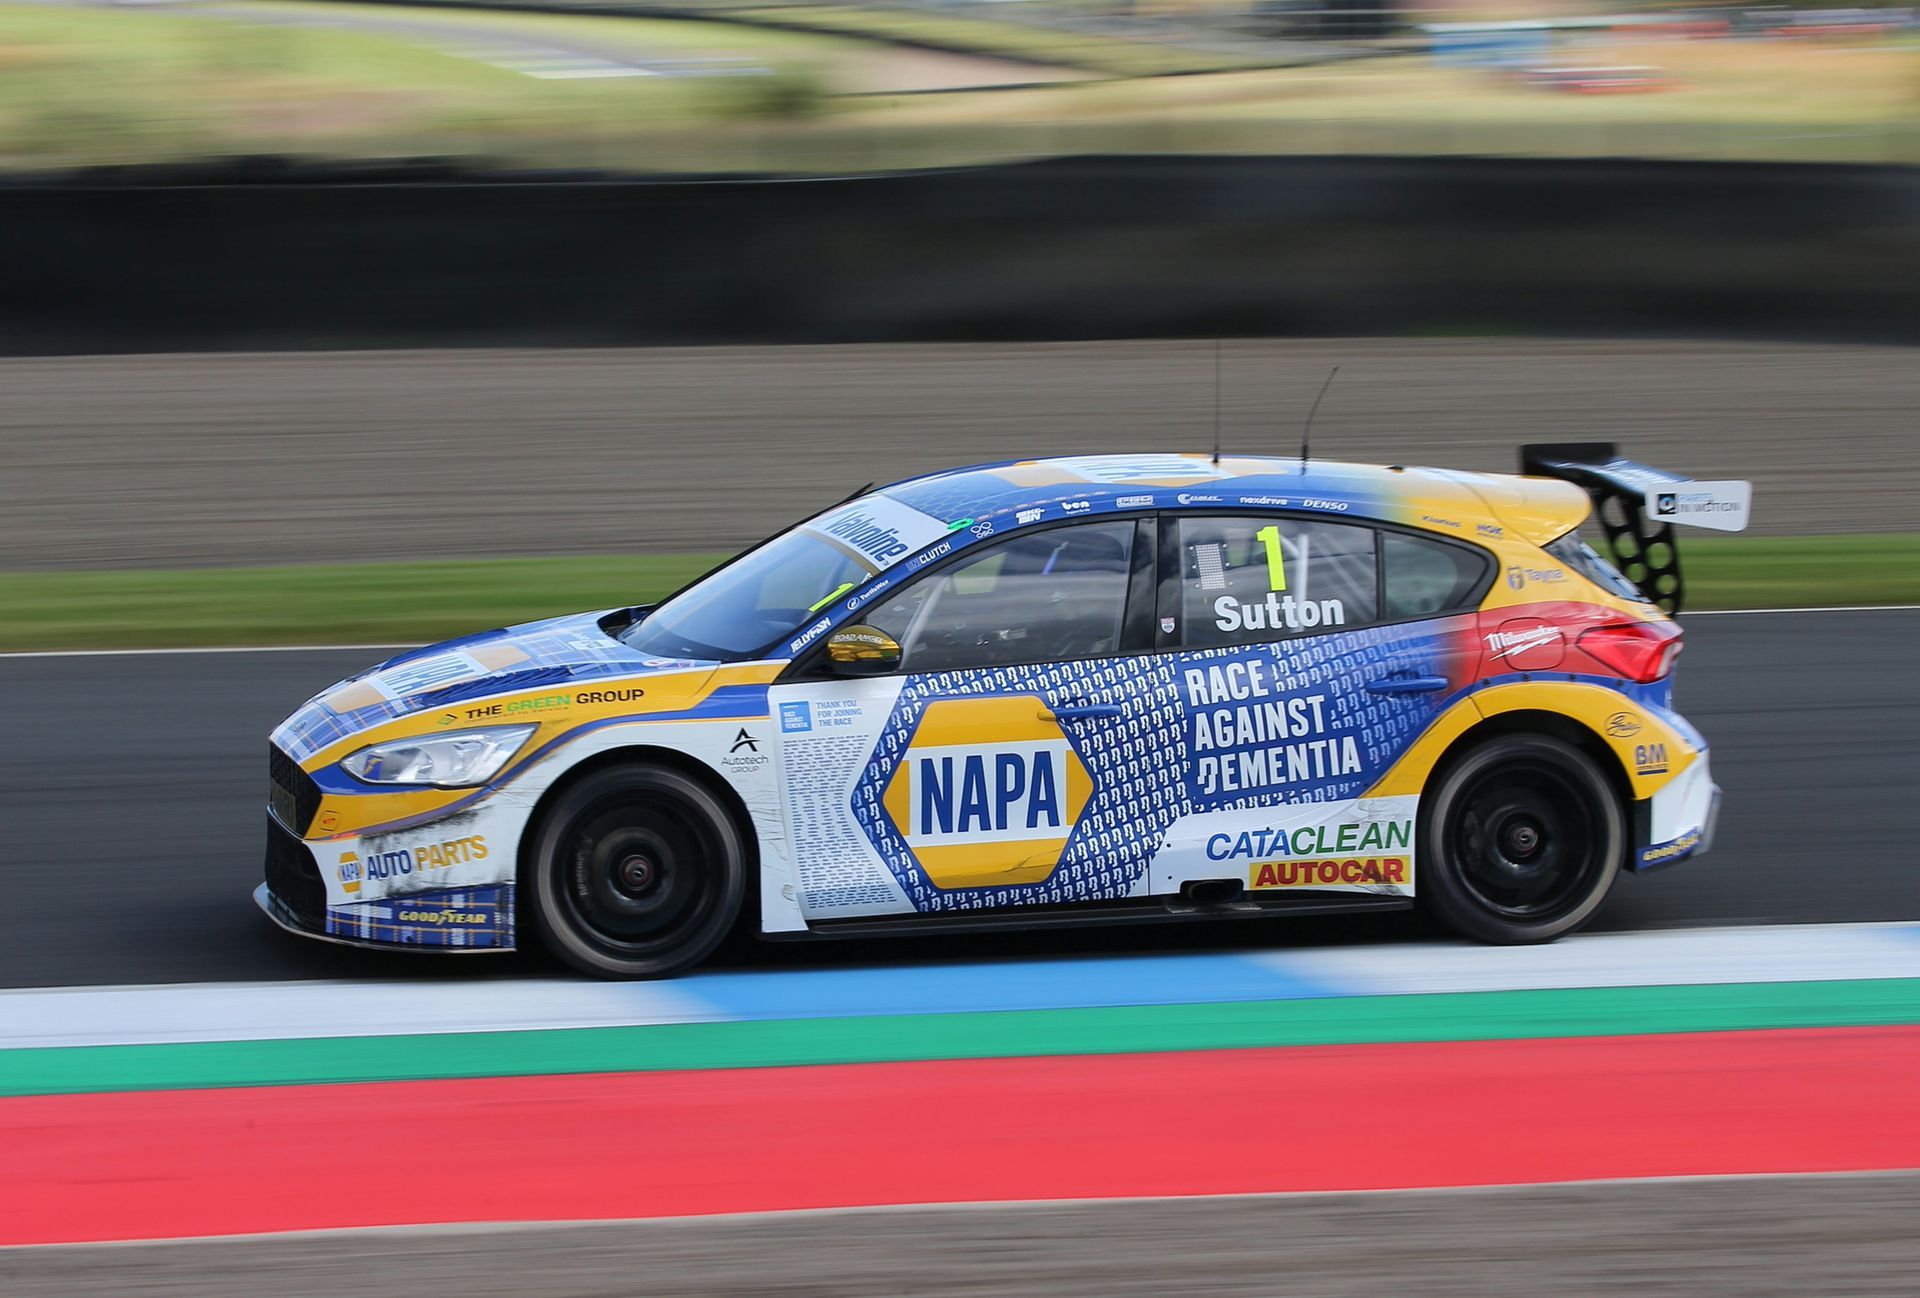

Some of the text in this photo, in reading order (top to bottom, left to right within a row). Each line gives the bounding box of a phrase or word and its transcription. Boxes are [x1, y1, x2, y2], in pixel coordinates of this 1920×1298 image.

[1303, 498, 1348, 511] DENSO
[1257, 526, 1287, 591] 1
[1214, 592, 1345, 632] Sutton
[1184, 659, 1269, 706] RACE
[465, 688, 645, 719] THE GREEN GROUP
[817, 700, 857, 709] THANK YOU
[817, 710, 832, 718] FOR
[819, 719, 832, 727] THE
[1195, 695, 1325, 751] AGAINST
[720, 754, 769, 766] Autotech
[1197, 736, 1362, 795] DEMENTIA
[920, 750, 1061, 836] NAPA
[367, 834, 490, 881] AUTO PARTS
[1206, 820, 1412, 861] CATACLEAN
[1255, 858, 1404, 887] AUTOCAR
[399, 909, 487, 925] GOODYEAR
